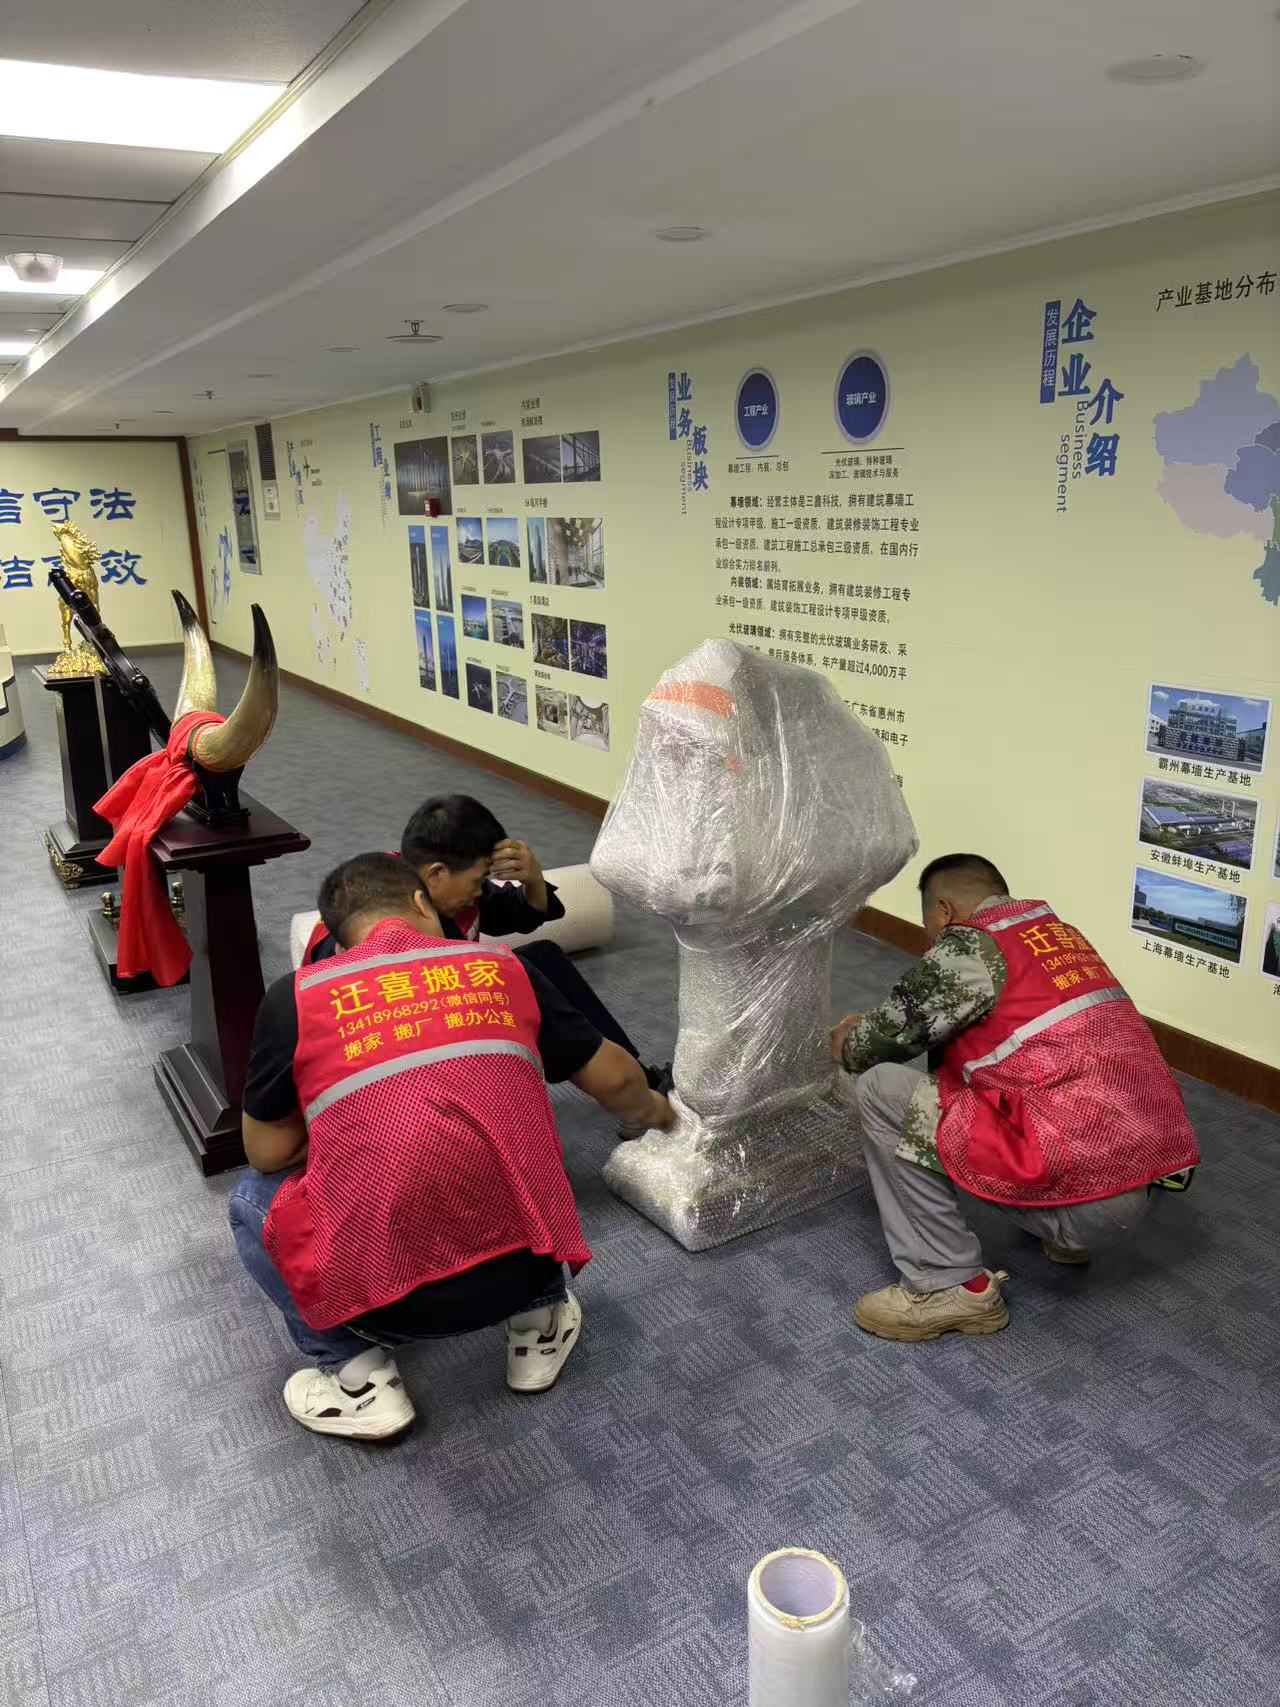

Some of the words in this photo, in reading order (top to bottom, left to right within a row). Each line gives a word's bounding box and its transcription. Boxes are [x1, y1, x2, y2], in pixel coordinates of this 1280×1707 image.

[1156, 270, 1277, 312] 产业基地分布
[1042, 308, 1059, 388] 发展历程
[743, 404, 769, 417] 工程产业
[846, 391, 877, 406] 玻璃产业
[1058, 297, 1097, 397] 企业
[1084, 378, 1124, 477] 介绍
[677, 372, 692, 438] 业务
[692, 425, 708, 491] 板块
[1071, 400, 1089, 480] Business
[1056, 434, 1070, 513] segment
[1158, 757, 1252, 787] 霸州幕墙生产基地
[1150, 849, 1241, 884] 安徽蚌埠生产基地
[1052, 969, 1084, 990] 搬家
[1141, 939, 1230, 979] 上海幕墙生产基地
[330, 959, 506, 1020] 迁喜搬家
[344, 1031, 384, 1062] 搬家
[393, 1018, 433, 1041] 搬厂
[443, 1008, 518, 1030] 搬办公室
